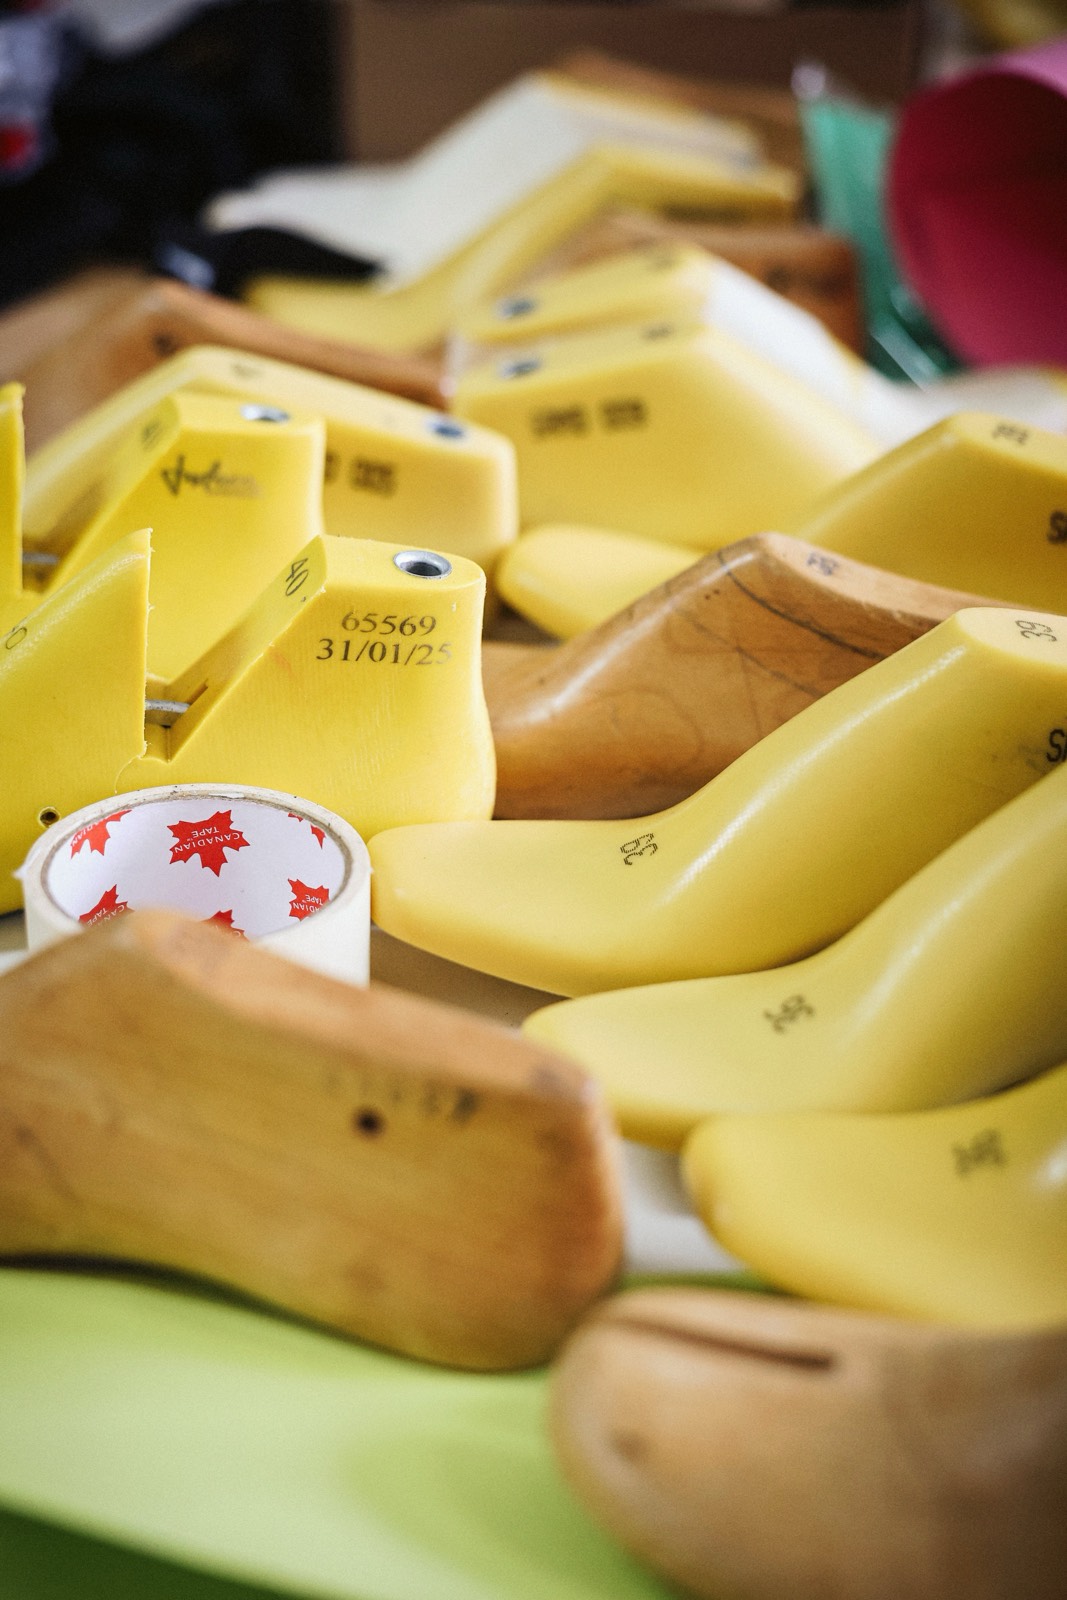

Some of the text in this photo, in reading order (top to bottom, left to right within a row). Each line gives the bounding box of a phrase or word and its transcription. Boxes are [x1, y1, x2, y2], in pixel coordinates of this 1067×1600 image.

[341, 610, 437, 637] 65569
[1015, 619, 1058, 642] 39
[316, 638, 453, 666] 31/01/25
[174, 832, 241, 854] CANADIAN
[620, 833, 659, 866] 39
